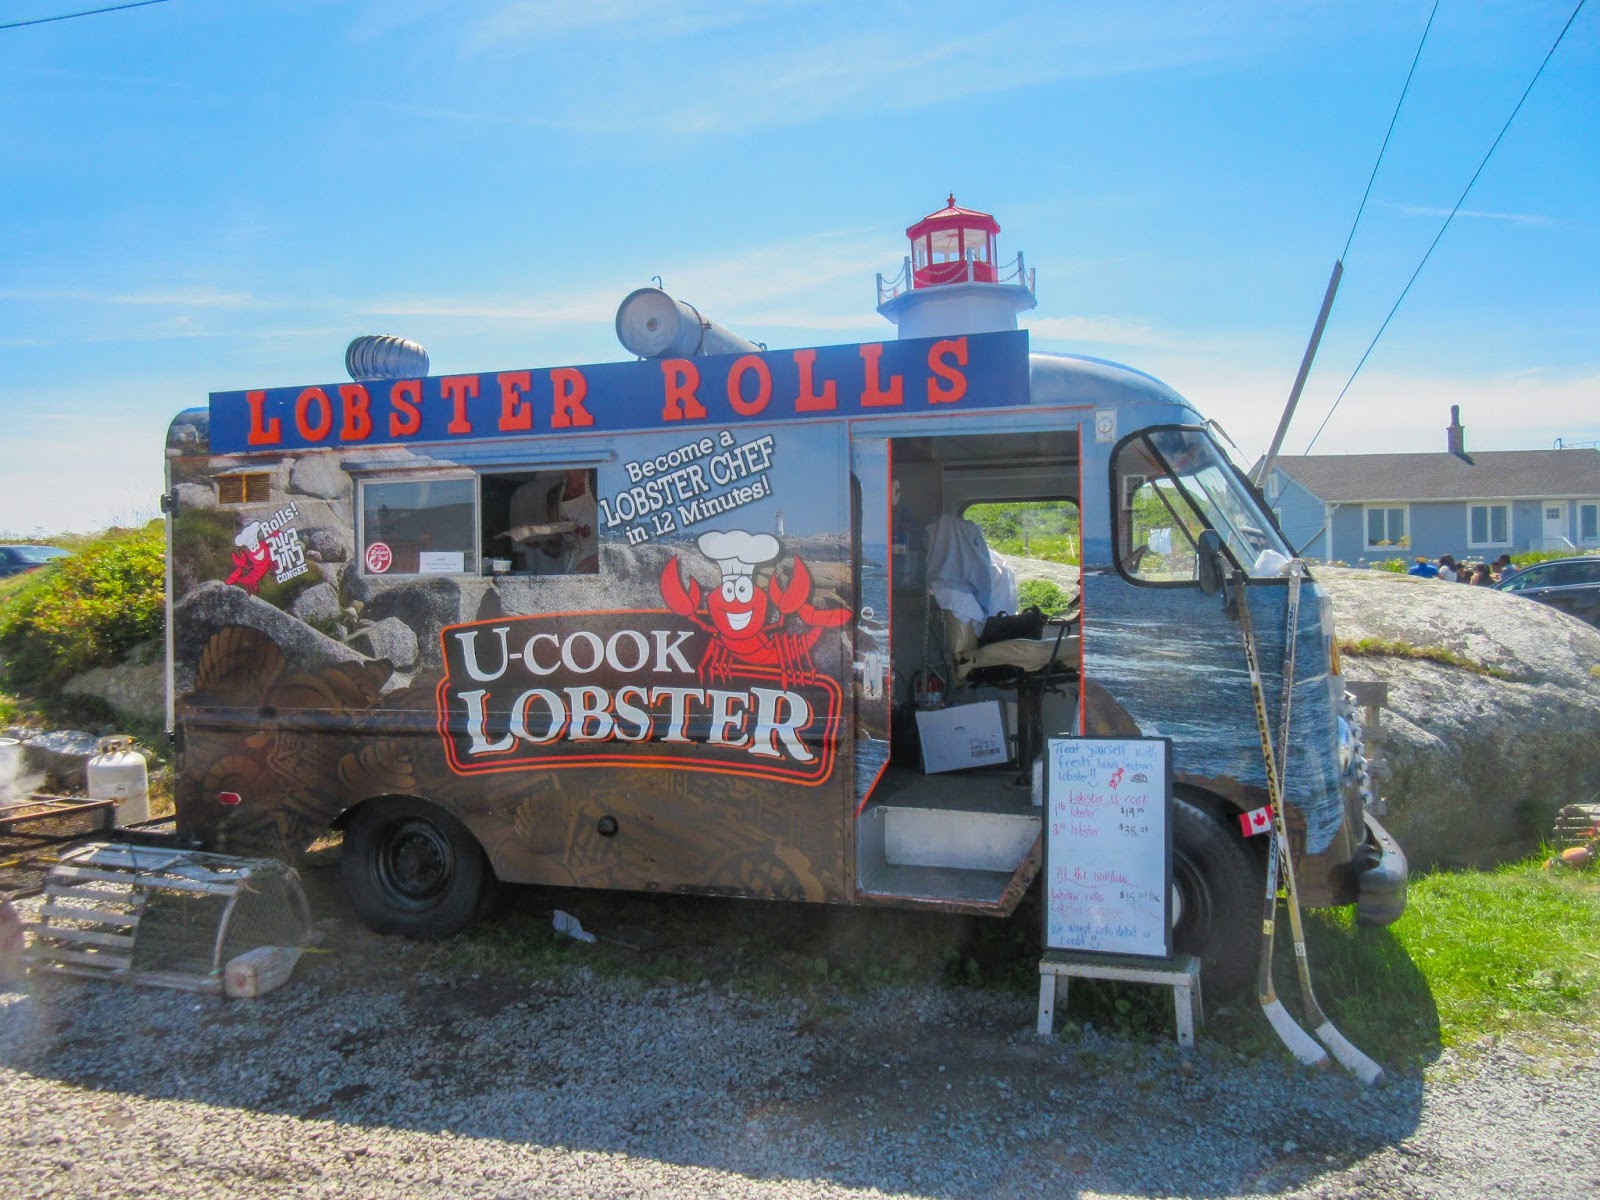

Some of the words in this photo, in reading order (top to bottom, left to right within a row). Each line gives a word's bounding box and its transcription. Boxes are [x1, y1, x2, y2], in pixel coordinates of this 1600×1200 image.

[245, 367, 594, 446] LOBSTER
[660, 336, 969, 422] ROLLS
[600, 464, 710, 528] LOBSTER
[709, 434, 775, 486] CHEF
[625, 438, 714, 483] Become
[719, 430, 735, 447] a
[259, 501, 300, 539] Rolls!
[625, 525, 649, 546] in
[651, 511, 676, 536] 12
[677, 474, 773, 527] Minutes!
[276, 563, 309, 584] CONGEE
[454, 626, 696, 682] U-COOK
[458, 685, 816, 763] LOBSTER
[1052, 741, 1080, 754] Treat
[1086, 742, 1129, 757] yourself
